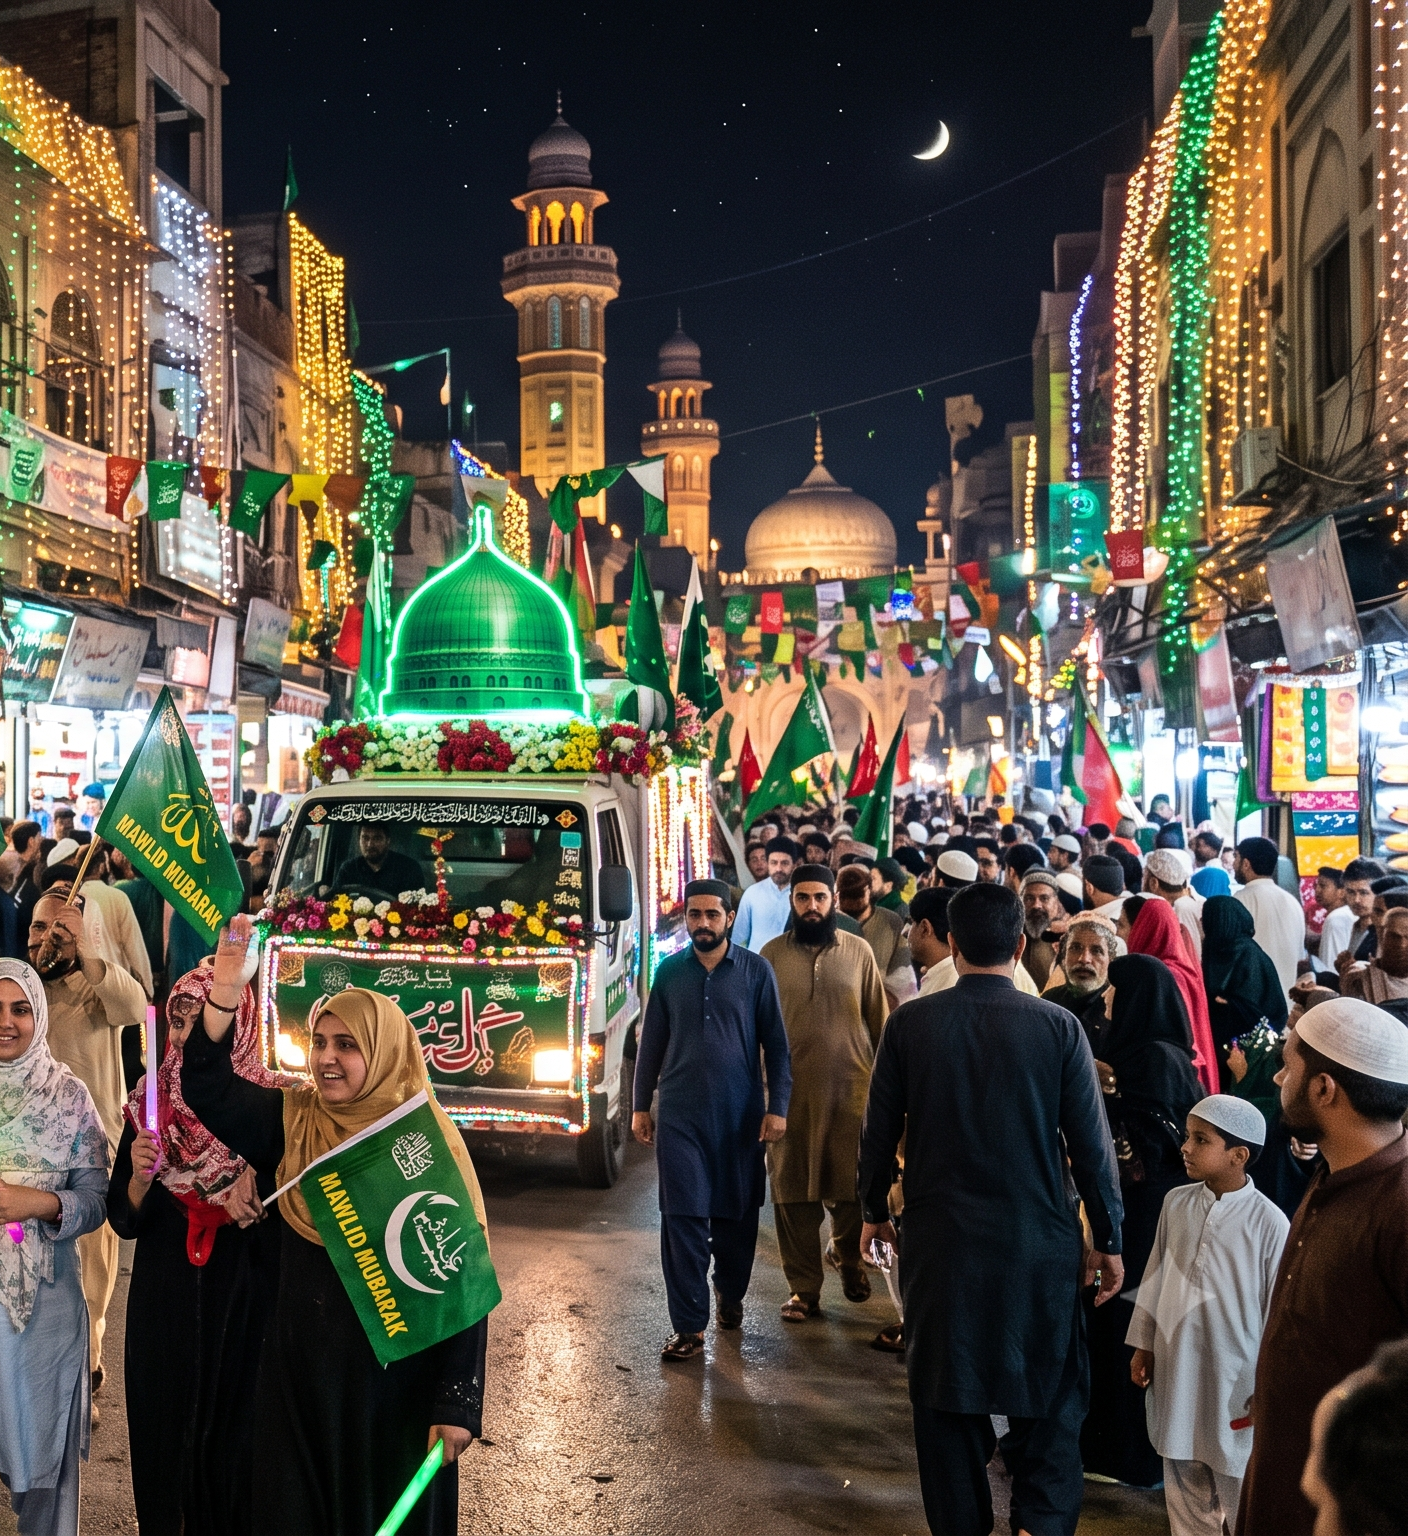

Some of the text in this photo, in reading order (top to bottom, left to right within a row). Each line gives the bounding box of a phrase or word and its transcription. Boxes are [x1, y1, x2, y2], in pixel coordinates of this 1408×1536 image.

[114, 813, 170, 869] MAWLID
[162, 860, 223, 932] MUBARAK
[318, 1171, 409, 1339] MAWLID MUBARAK
